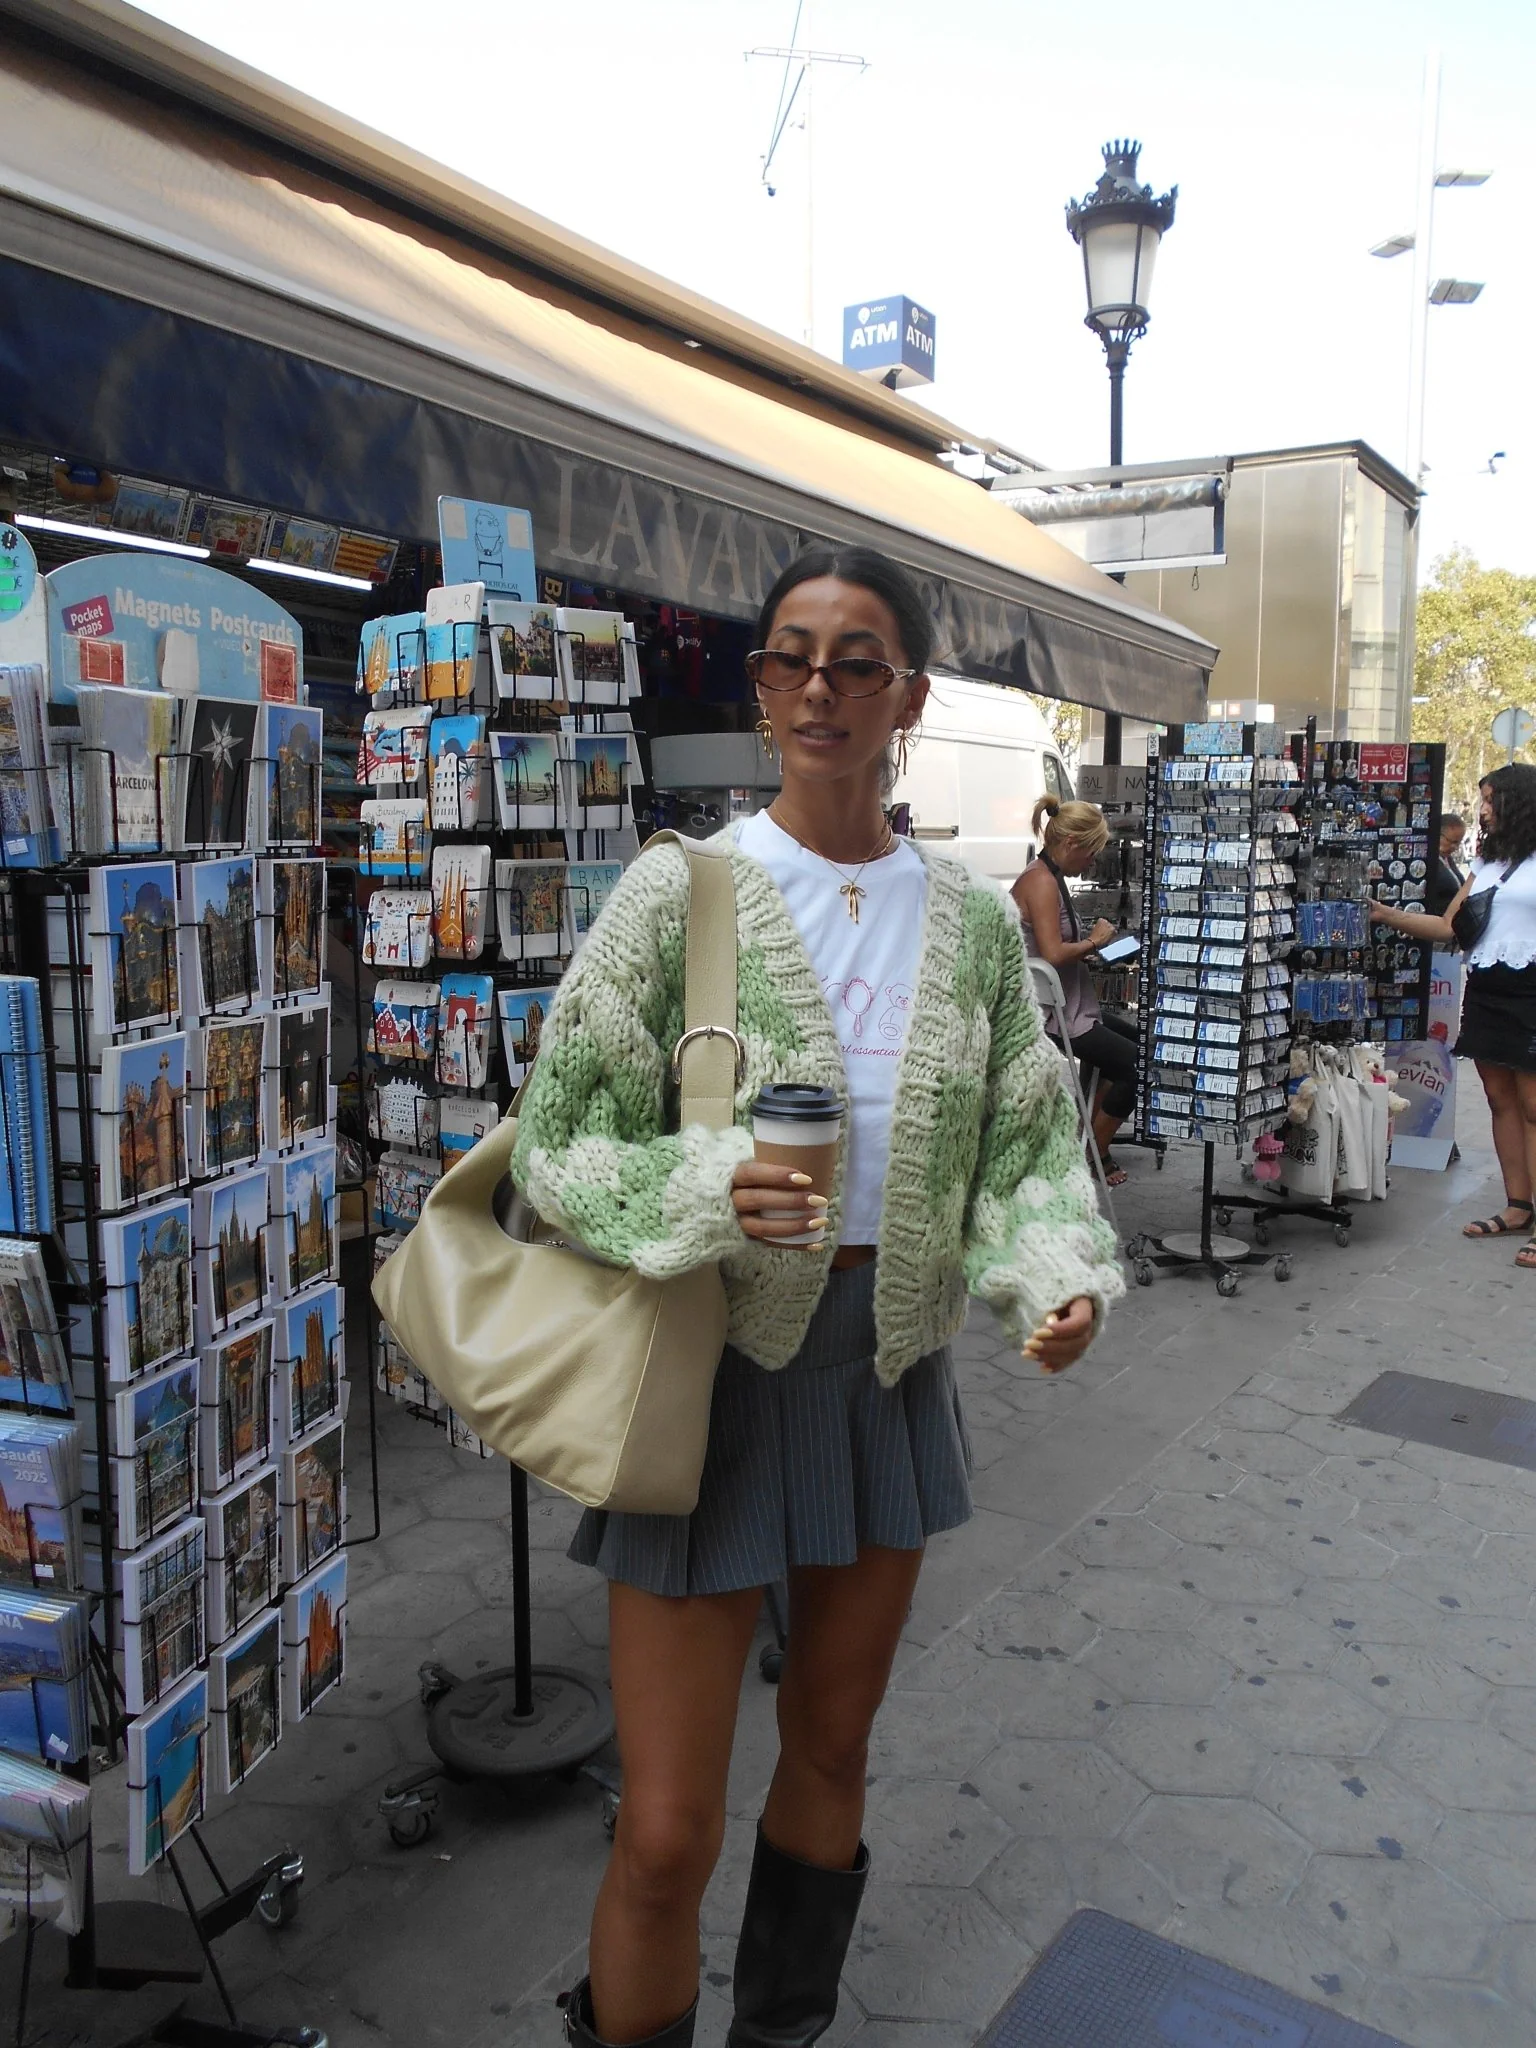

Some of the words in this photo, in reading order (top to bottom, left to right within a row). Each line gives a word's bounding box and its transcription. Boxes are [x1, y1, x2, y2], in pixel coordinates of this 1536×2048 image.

[850, 320, 898, 349] ATM
[906, 324, 933, 356] ATM
[70, 605, 104, 627] Pocket
[115, 587, 201, 630] Magnets
[210, 607, 294, 643] Postcards
[1361, 763, 1369, 775] 3
[1371, 765, 1379, 775] x
[1382, 763, 1404, 775] 11€
[579, 870, 614, 885] BAR
[580, 889, 611, 905] CE
[852, 1047, 903, 1057] essential
[1399, 1068, 1446, 1096] evian
[448, 1103, 480, 1114] BARCELONA
[13, 1468, 48, 1484] 2025
